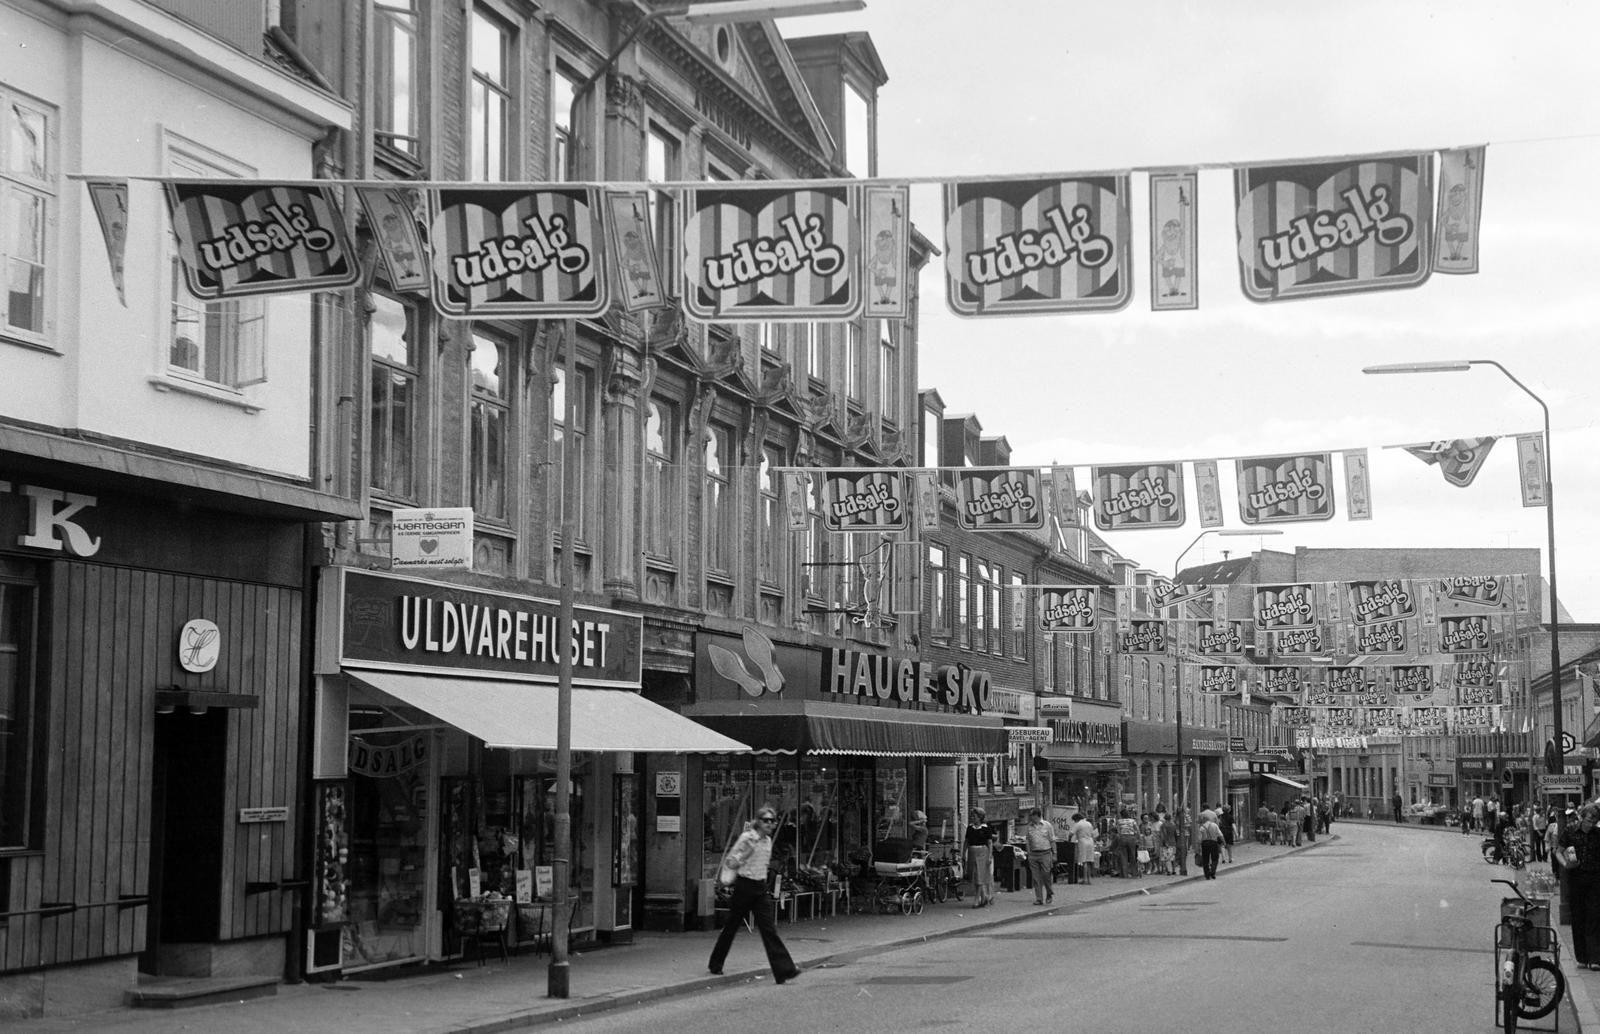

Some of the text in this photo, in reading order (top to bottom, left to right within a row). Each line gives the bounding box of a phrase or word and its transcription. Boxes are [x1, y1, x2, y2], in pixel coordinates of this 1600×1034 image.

[200, 203, 334, 272] udsalg
[1261, 184, 1411, 270] udsalg
[454, 213, 589, 286] udsalg
[705, 213, 843, 290] udsalg
[968, 205, 1112, 285] udsalg
[832, 482, 899, 518] udsalg
[967, 480, 1036, 517] udsalg
[1103, 476, 1175, 516] udsalg
[1249, 468, 1325, 510] udsalg
[0, 480, 101, 556] K
[1045, 595, 1092, 621] udsalg
[1261, 593, 1311, 621] udsalg
[1357, 583, 1408, 616] udsalg
[402, 595, 610, 668] ULDVAREHUSET
[1125, 628, 1164, 647] udsalg
[1201, 629, 1240, 648] udsalg
[1279, 630, 1320, 649] udsalg
[1360, 625, 1402, 647] udsalg
[1444, 623, 1487, 646] udsalg
[830, 648, 933, 703] HAUGE
[1203, 671, 1235, 688] udsalg
[1266, 672, 1298, 688] udsalg
[1330, 672, 1362, 688] udsalg
[1396, 671, 1429, 688] udsalg
[1459, 665, 1493, 681] udsalg
[349, 738, 425, 773] DSALG
[1542, 776, 1581, 785] Stopforbud
